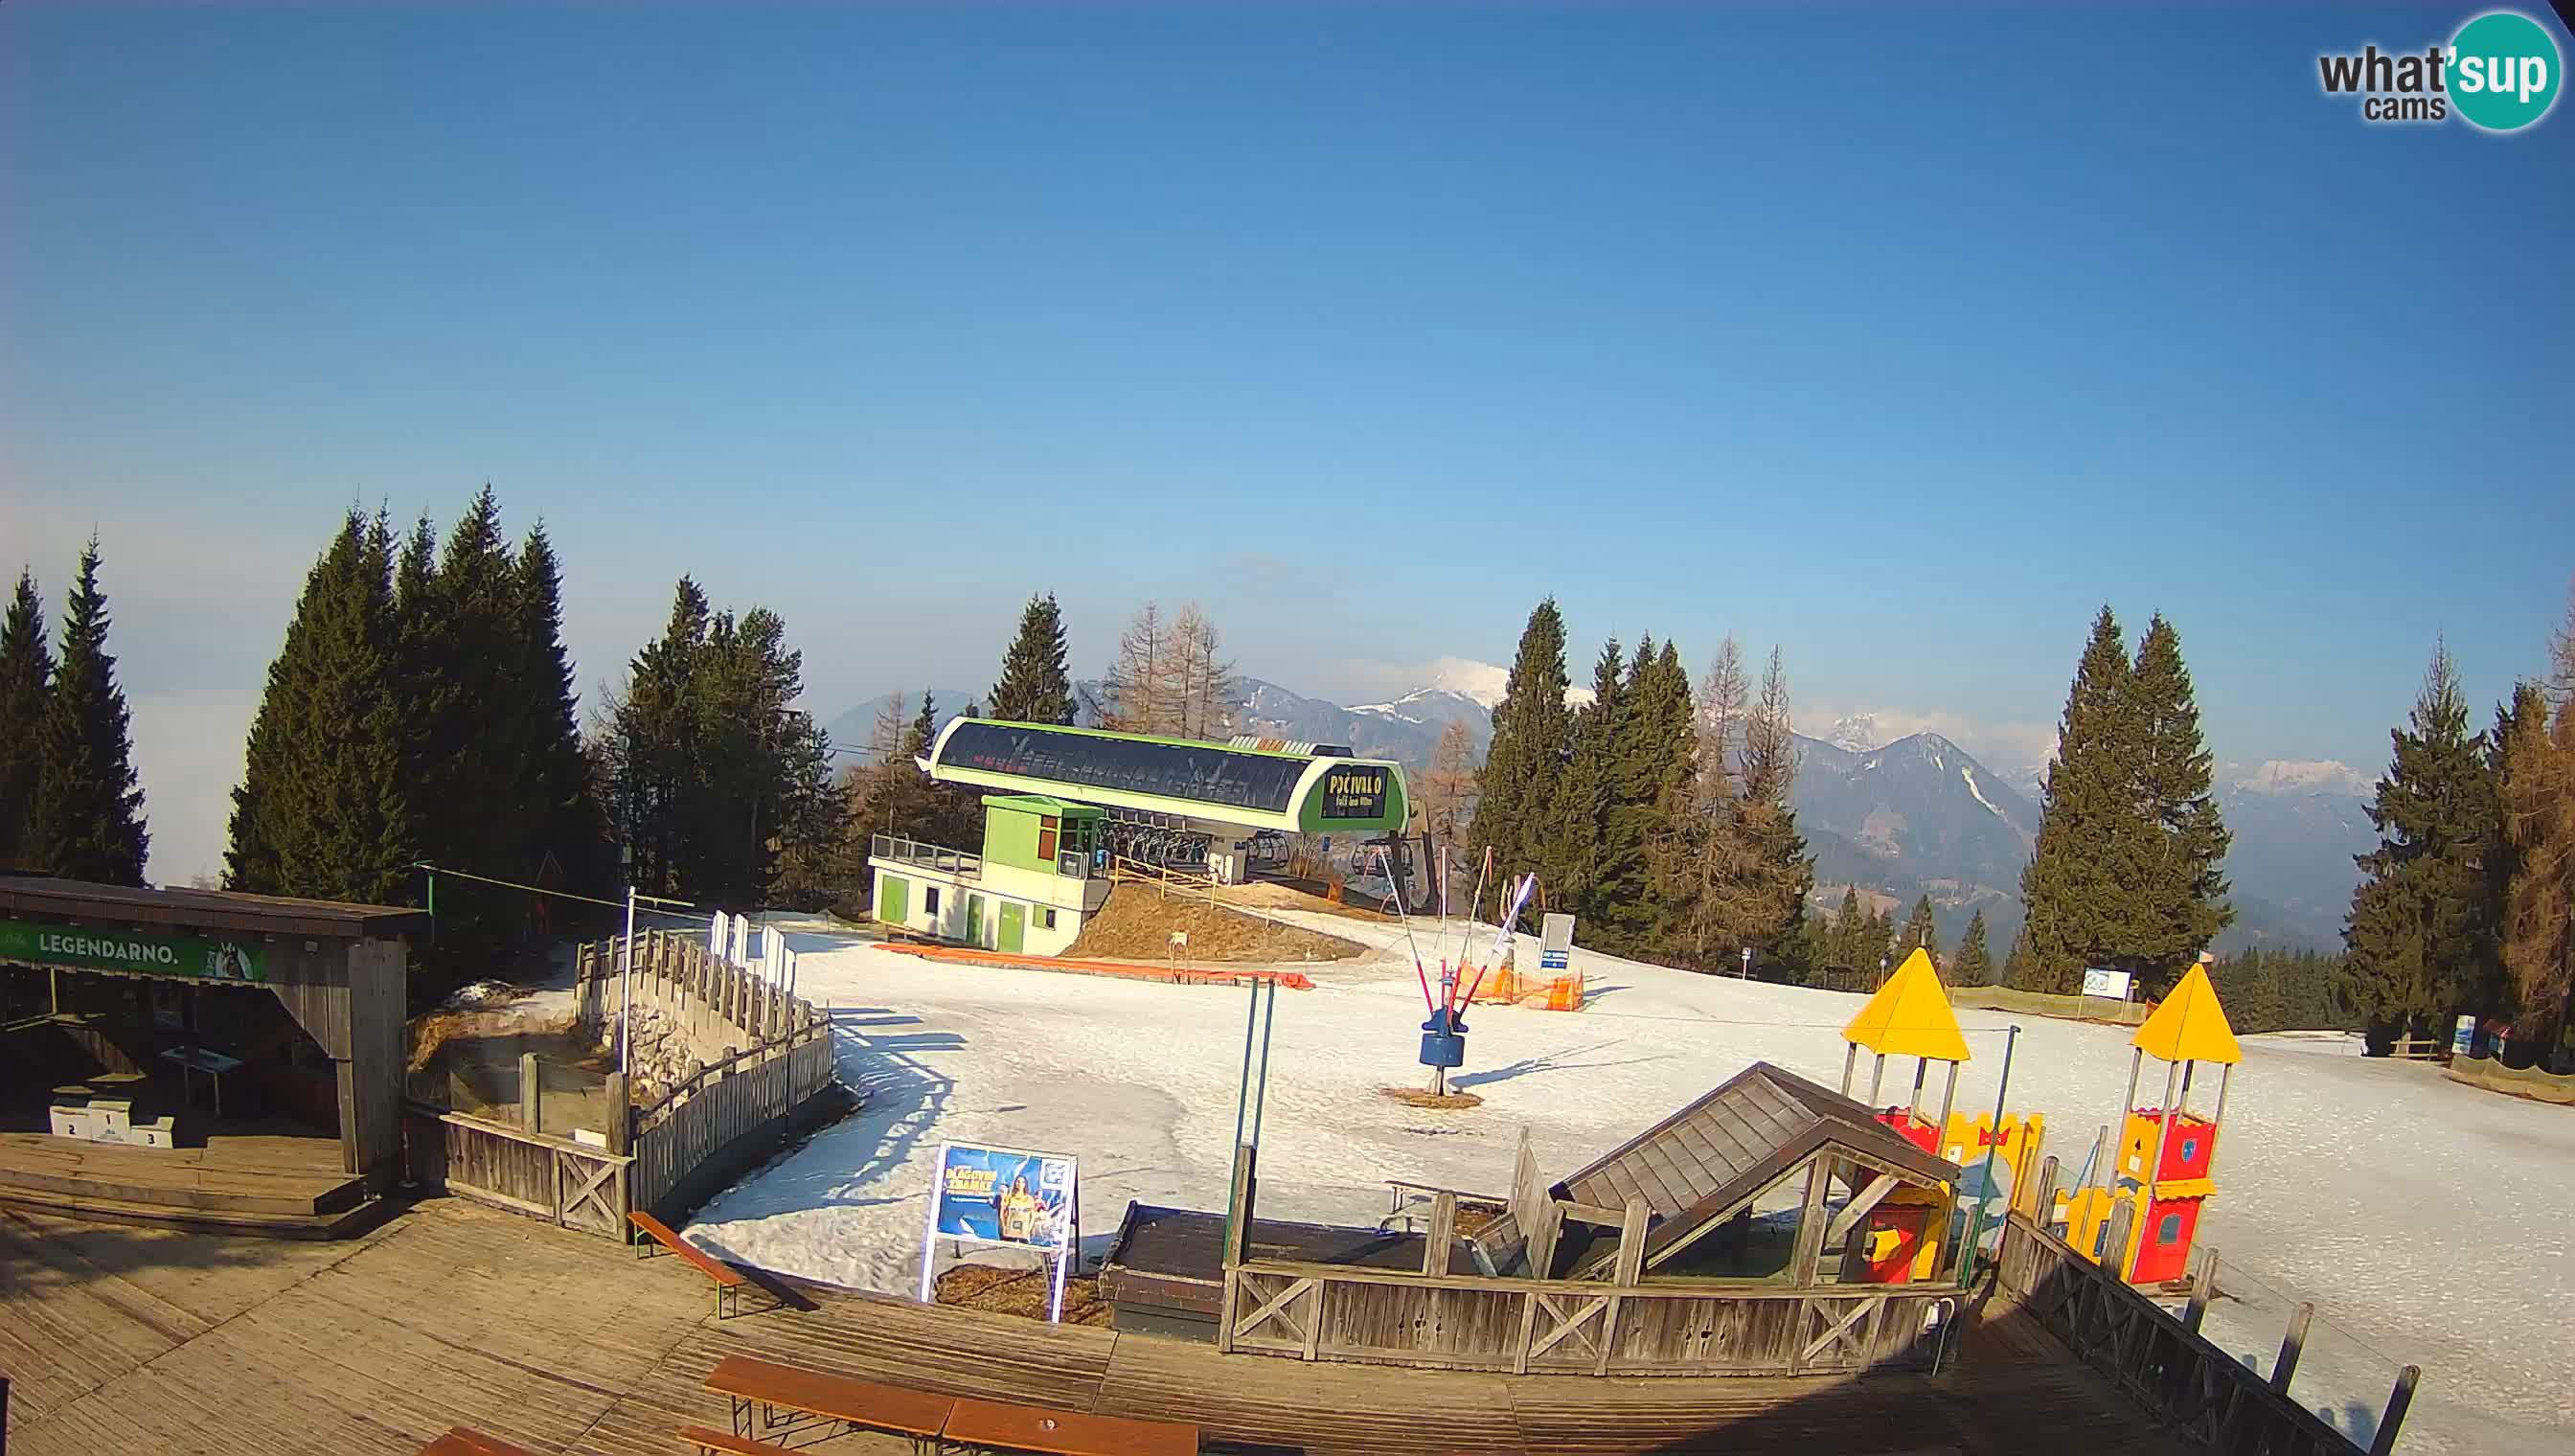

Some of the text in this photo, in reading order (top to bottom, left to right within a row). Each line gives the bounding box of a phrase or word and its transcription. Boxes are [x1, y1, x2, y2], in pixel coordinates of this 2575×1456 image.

[39, 933, 180, 966] LEGENDARNO.
[68, 1124, 77, 1135] 2
[147, 1133, 155, 1145] 3
